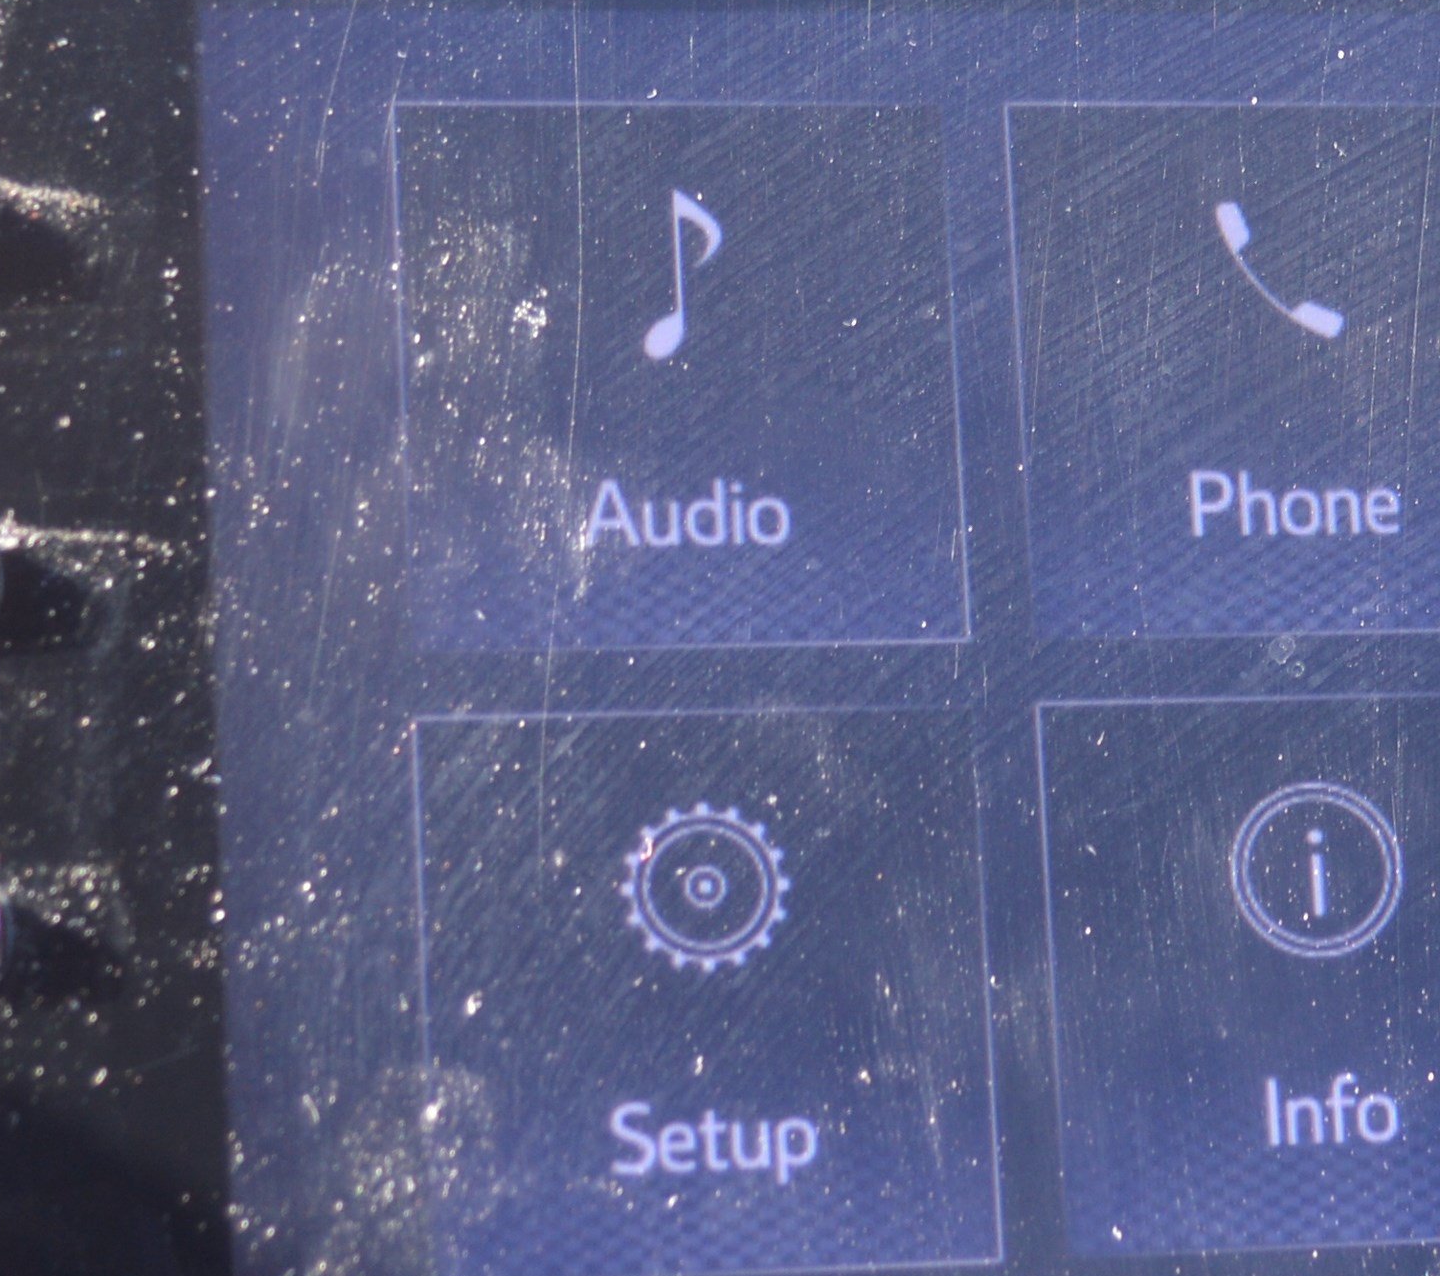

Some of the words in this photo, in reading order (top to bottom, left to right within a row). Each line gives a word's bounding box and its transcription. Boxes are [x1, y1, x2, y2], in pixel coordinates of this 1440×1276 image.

[584, 478, 792, 549] Audio
[1187, 469, 1402, 537] Phone
[610, 1103, 818, 1184] Setup
[1264, 1075, 1401, 1147] Info
